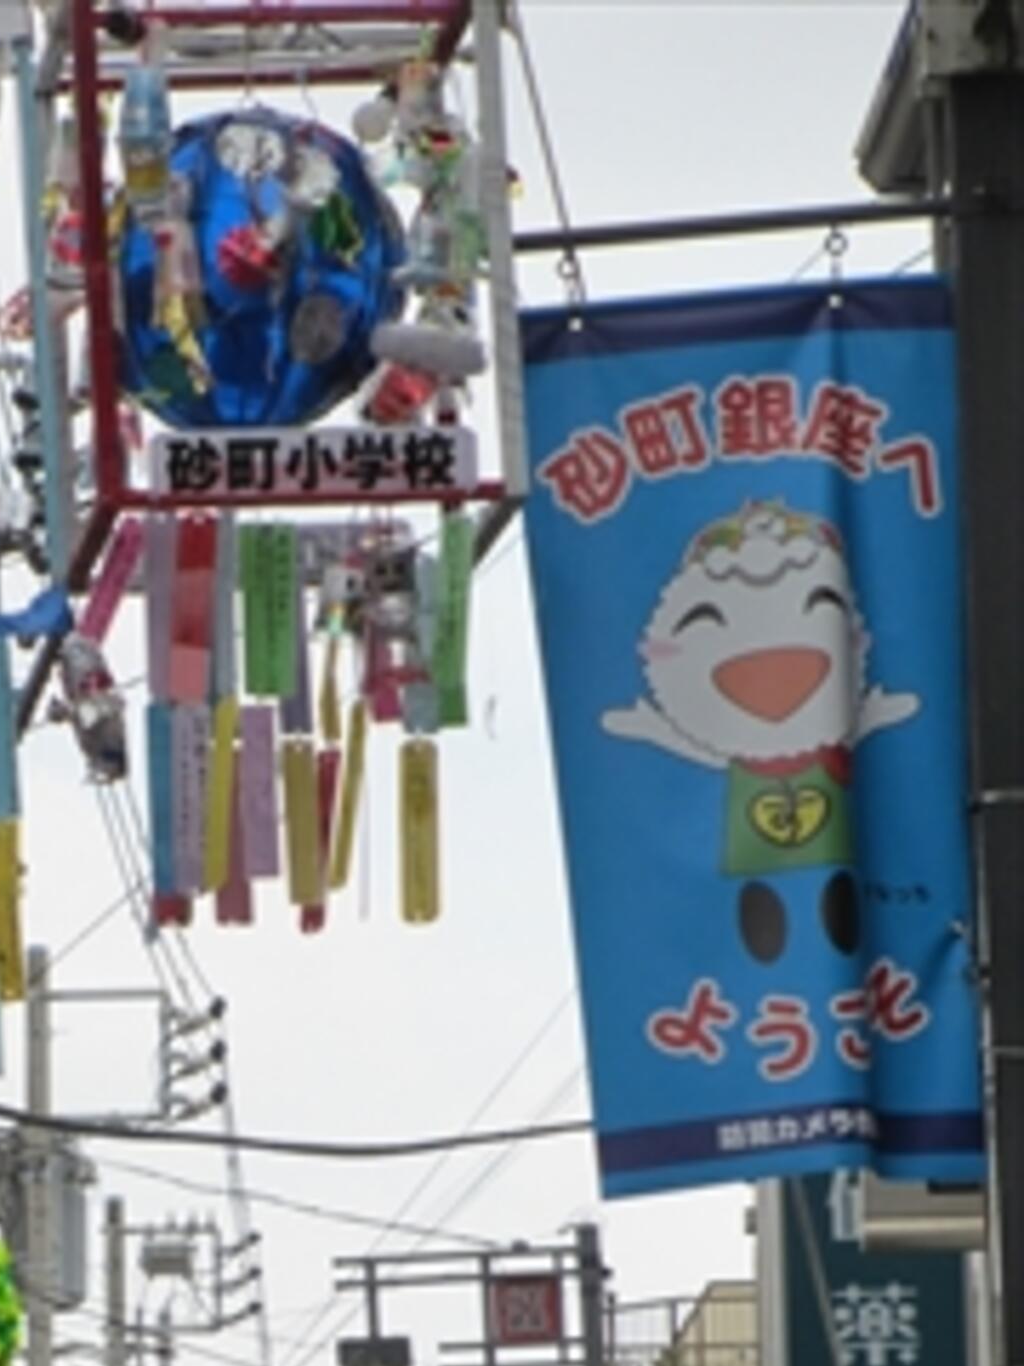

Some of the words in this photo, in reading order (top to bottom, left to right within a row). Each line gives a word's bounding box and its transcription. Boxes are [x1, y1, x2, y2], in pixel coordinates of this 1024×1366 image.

[163, 432, 457, 490] 砂町小学校
[540, 376, 942, 522] 砂町銀座へ
[648, 960, 928, 1081] ようこそ
